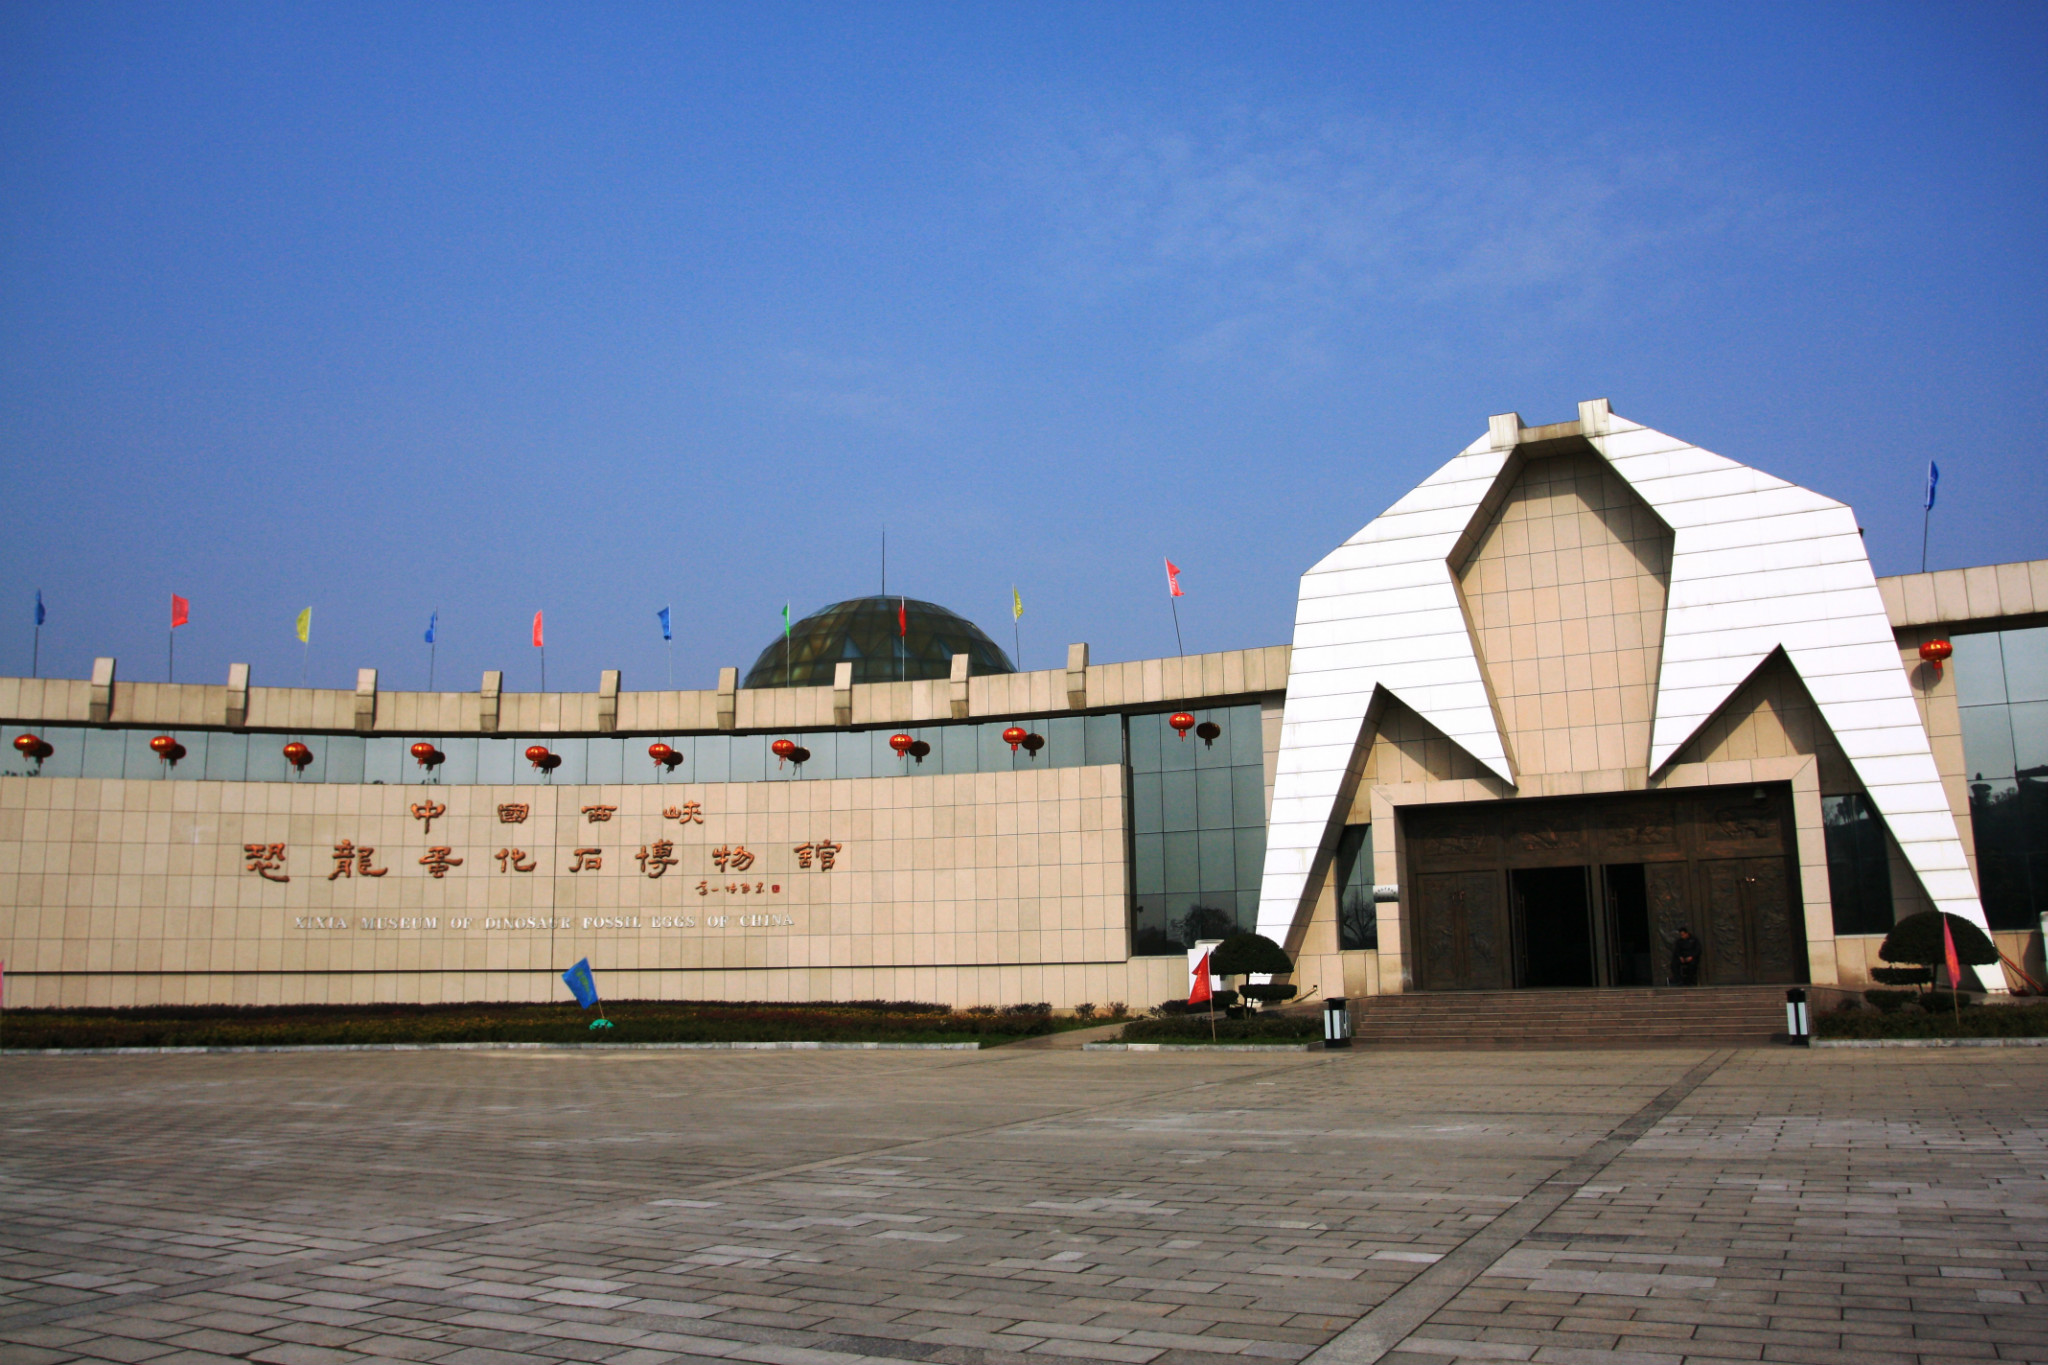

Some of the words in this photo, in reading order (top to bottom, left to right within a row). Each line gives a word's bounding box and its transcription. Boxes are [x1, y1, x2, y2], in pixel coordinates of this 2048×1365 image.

[294, 916, 348, 930] XIXIA
[361, 916, 438, 930] MUSEUM
[450, 916, 473, 930] OF
[485, 916, 571, 930] DINOSAUR
[583, 916, 641, 930] FOSSIL
[651, 915, 695, 929] EGGS
[707, 914, 729, 929] OF
[739, 912, 795, 928] CHINA
